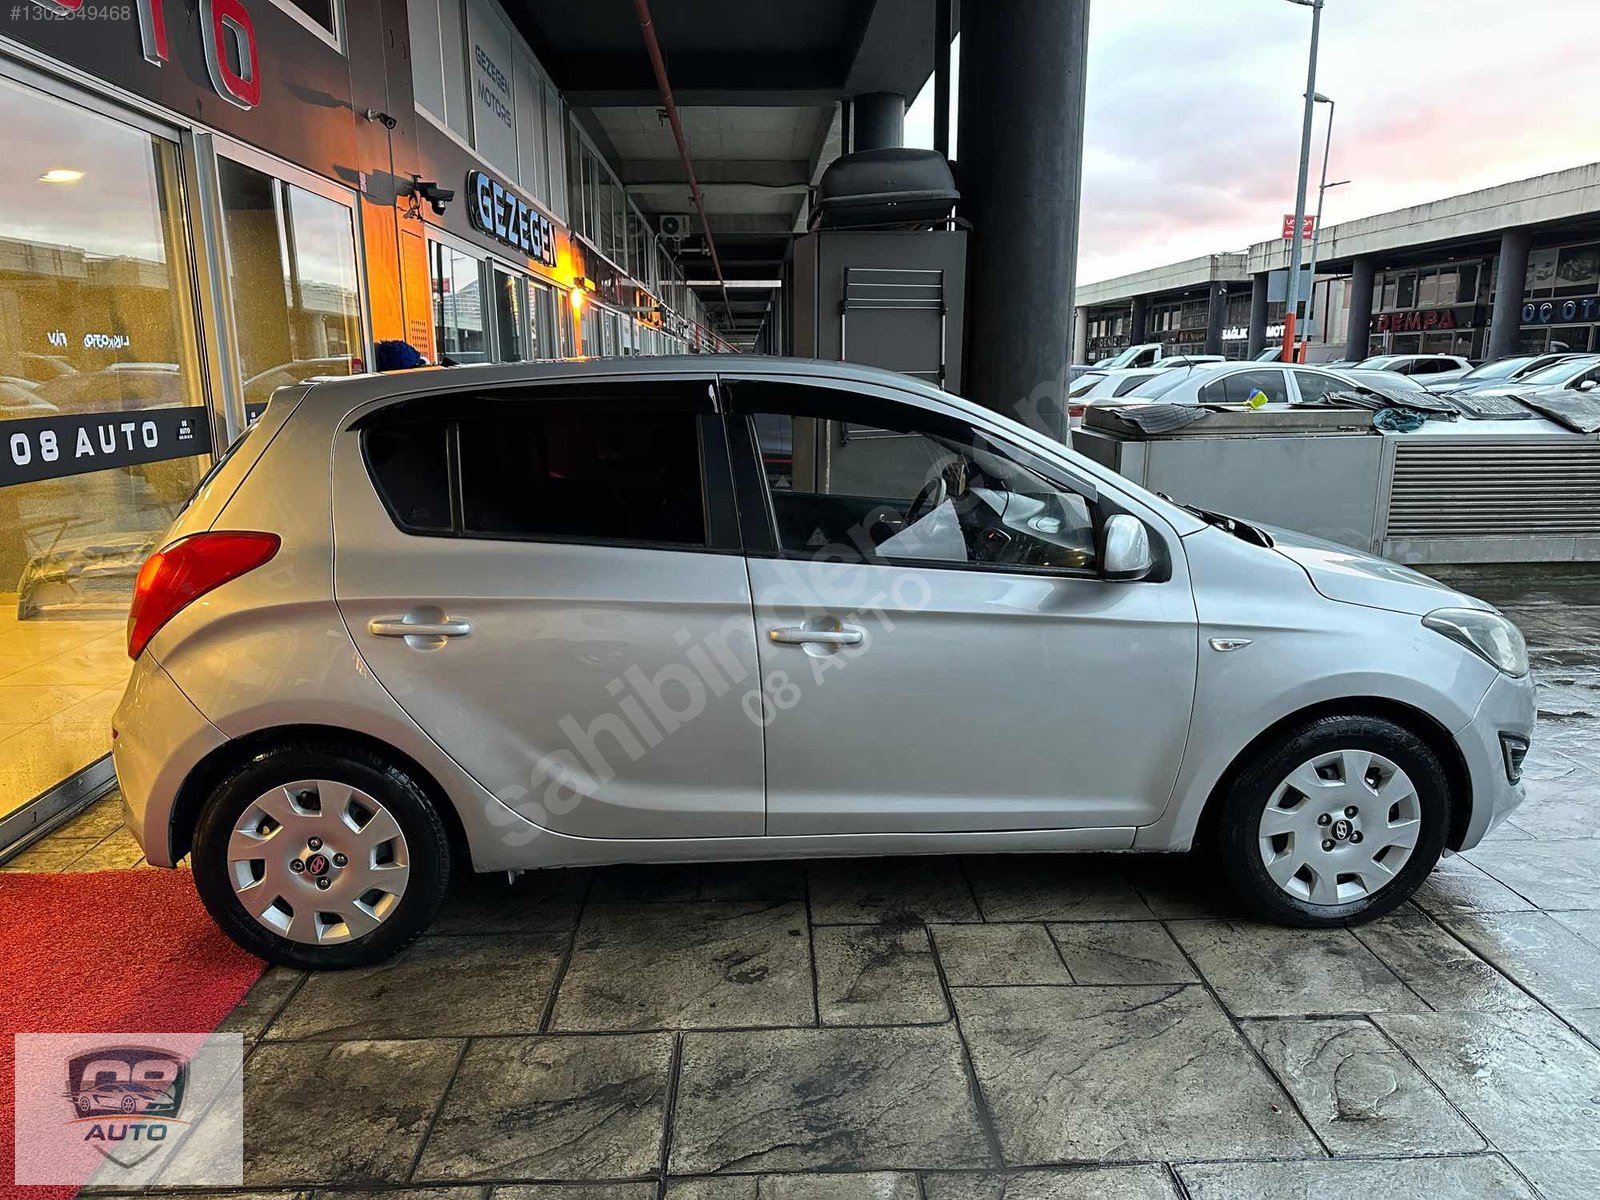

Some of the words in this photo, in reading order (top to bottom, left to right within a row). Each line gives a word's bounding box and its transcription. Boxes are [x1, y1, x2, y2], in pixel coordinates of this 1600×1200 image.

[475, 44, 510, 99] GEZEGEN
[478, 78, 511, 128] MOTORS
[476, 171, 557, 267] GEZEGEN
[1377, 309, 1456, 332] DEMPA
[1562, 299, 1600, 320] OT
[10, 430, 59, 466] 08
[75, 420, 158, 458] AUTO
